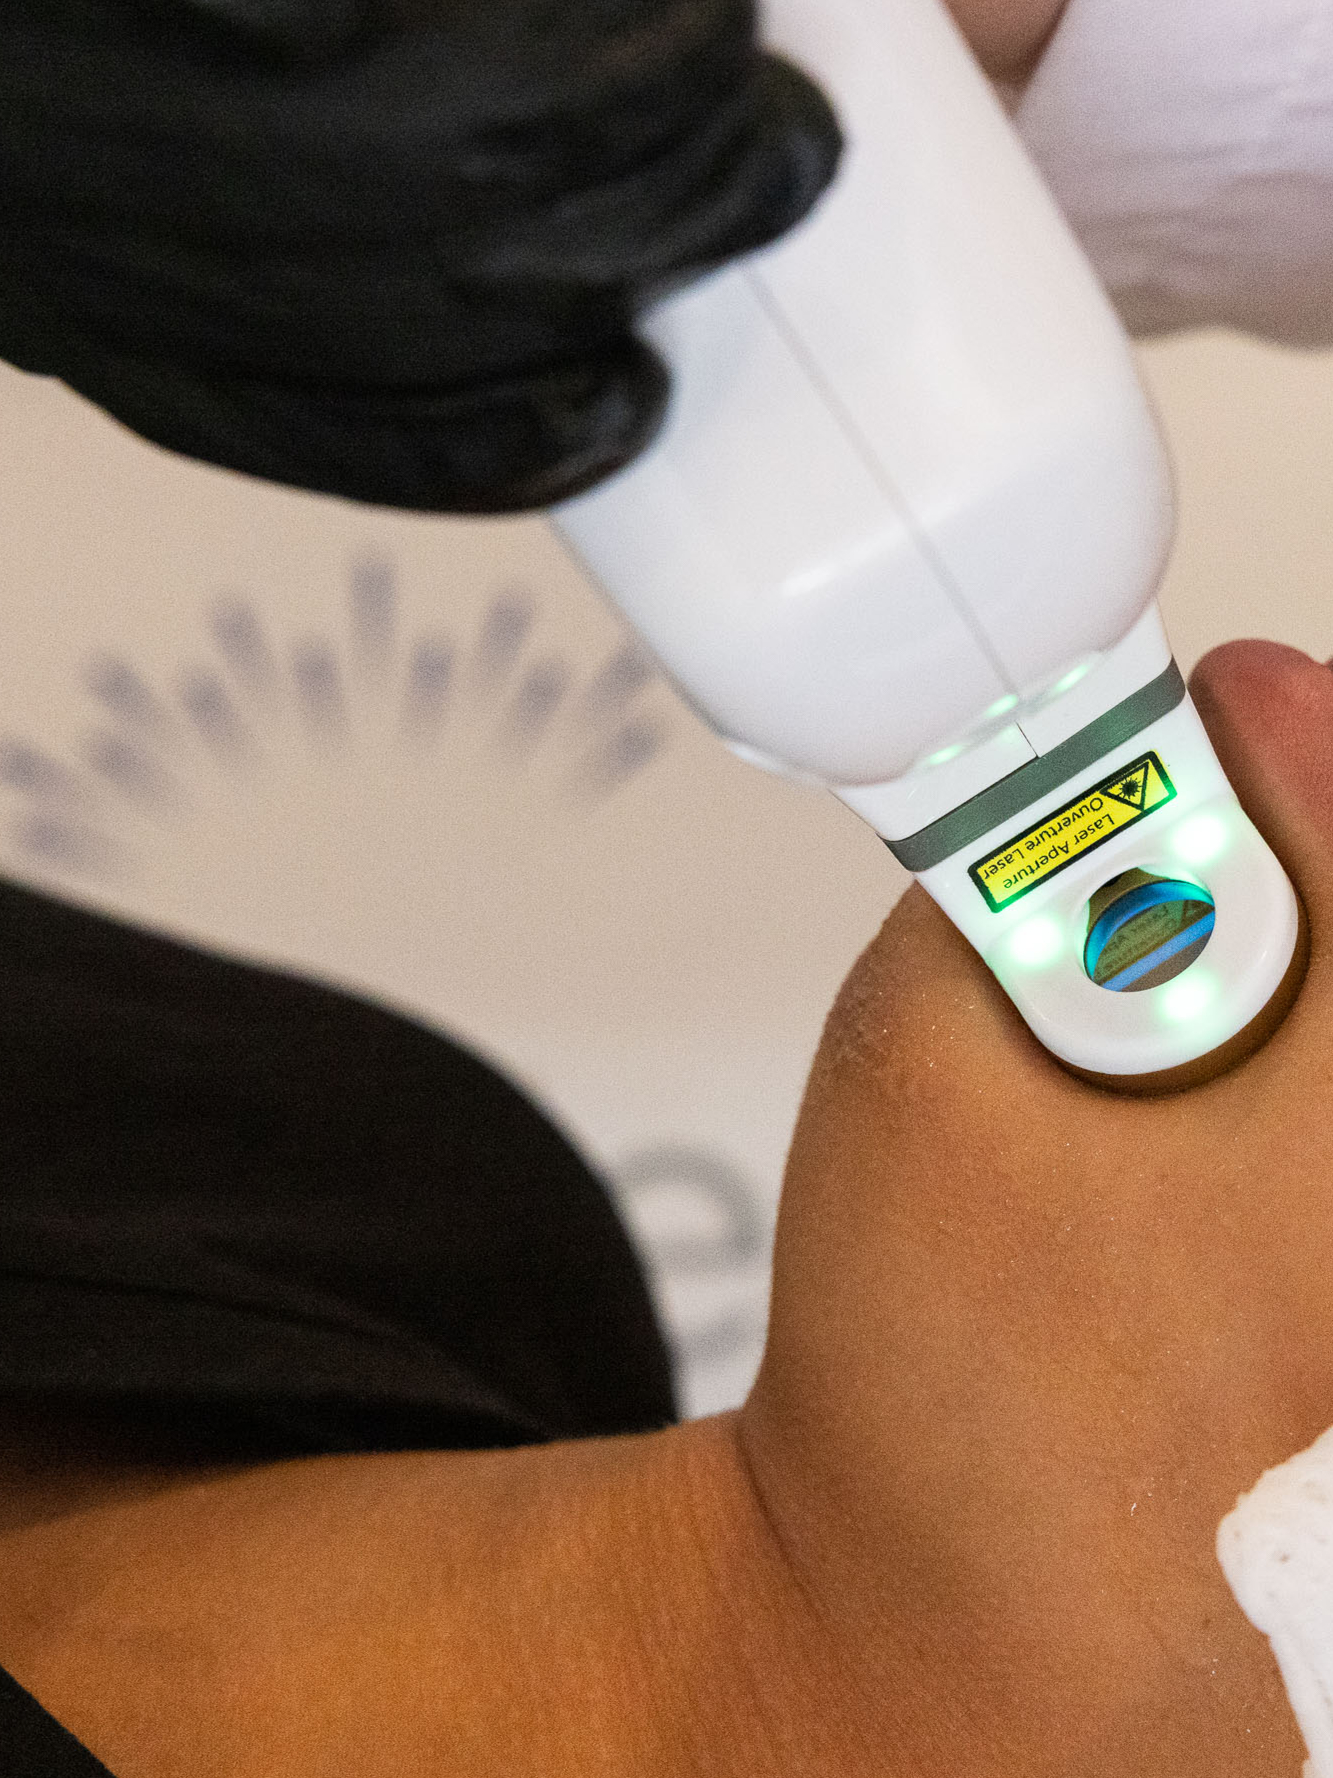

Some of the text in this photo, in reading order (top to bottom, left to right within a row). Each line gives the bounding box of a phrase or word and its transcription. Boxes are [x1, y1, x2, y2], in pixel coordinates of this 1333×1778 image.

[983, 797, 1104, 880] Ouverture Laser
[1003, 813, 1115, 889] Laser Aperture
